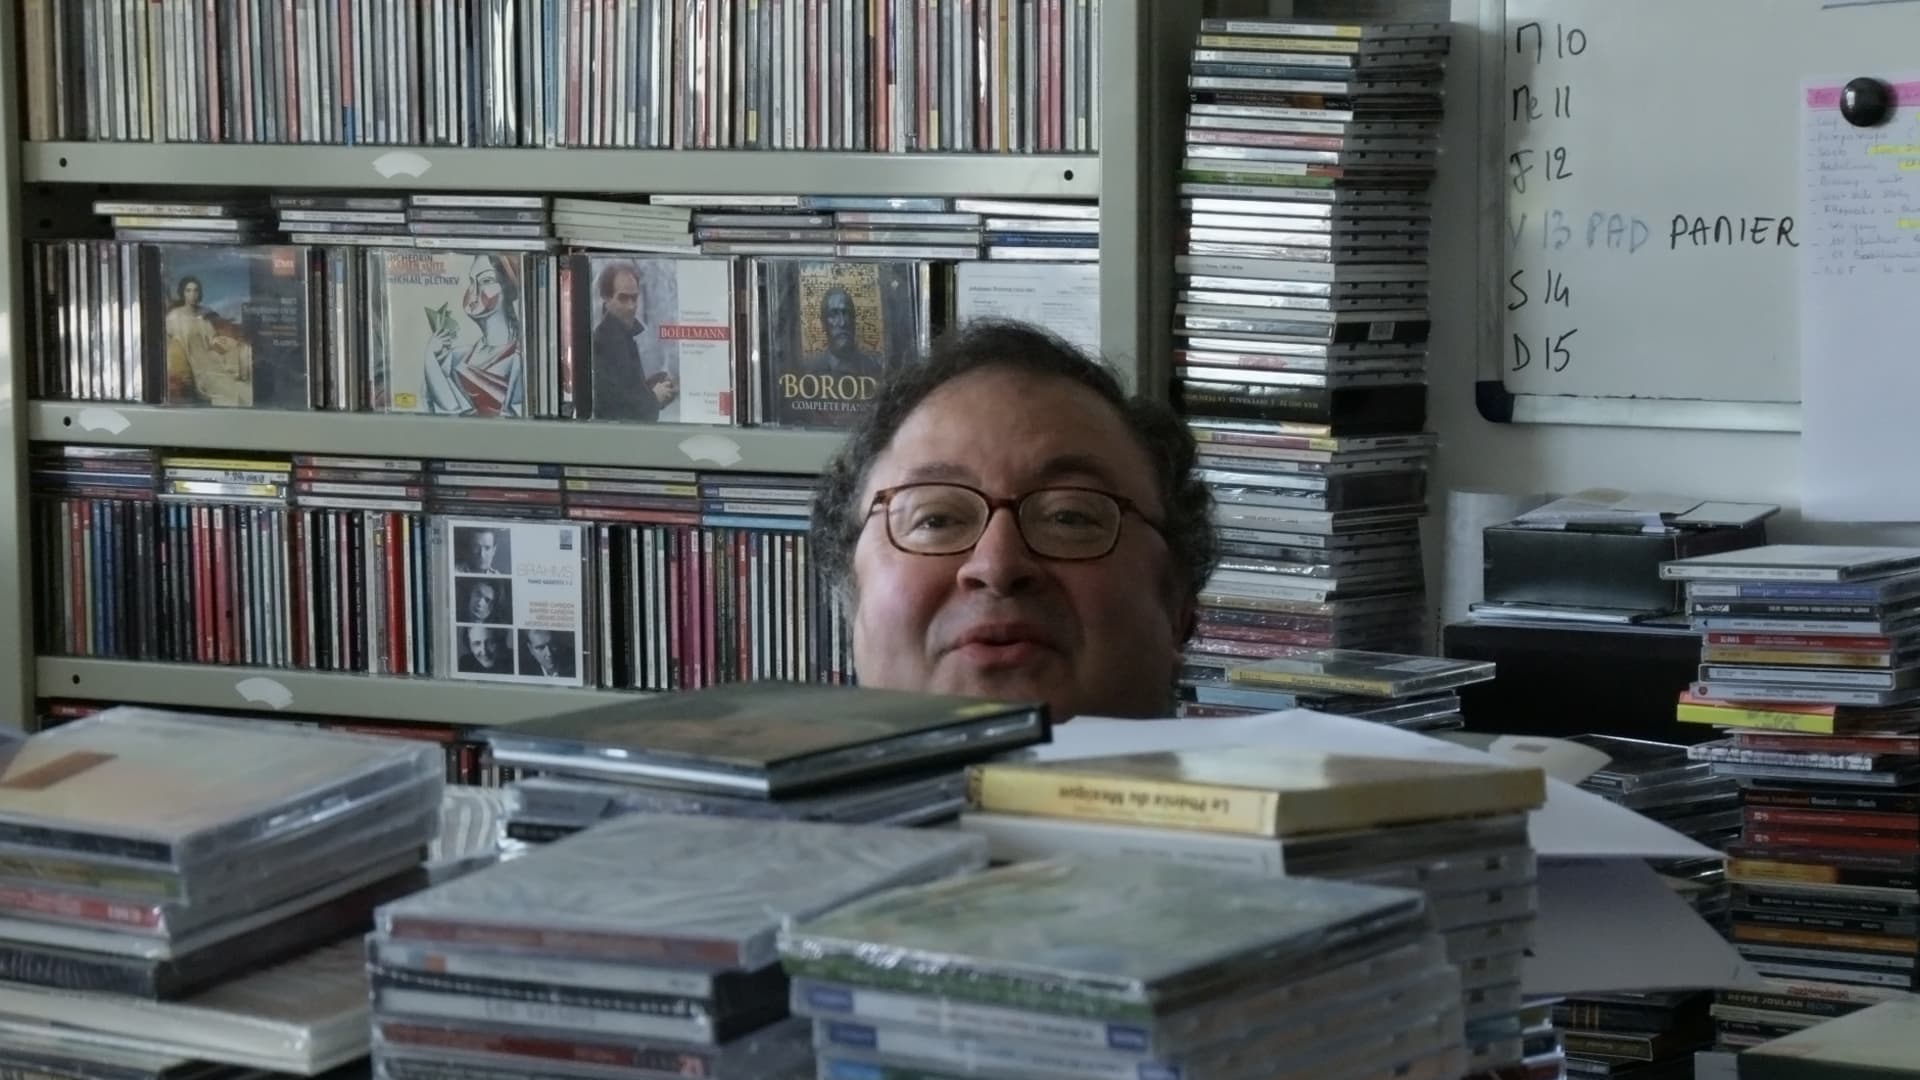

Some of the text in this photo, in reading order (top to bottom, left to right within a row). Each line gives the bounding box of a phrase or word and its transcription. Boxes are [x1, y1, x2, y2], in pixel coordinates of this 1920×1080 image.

[1556, 23, 1587, 58] 10
[1545, 146, 1573, 181] 12
[1542, 210, 1572, 251] 13
[1586, 211, 1649, 253] PAD
[1669, 214, 1800, 250] PANIER
[1508, 269, 1571, 311] S 14
[1511, 328, 1579, 372] D 15
[1127, 791, 1150, 807] du
